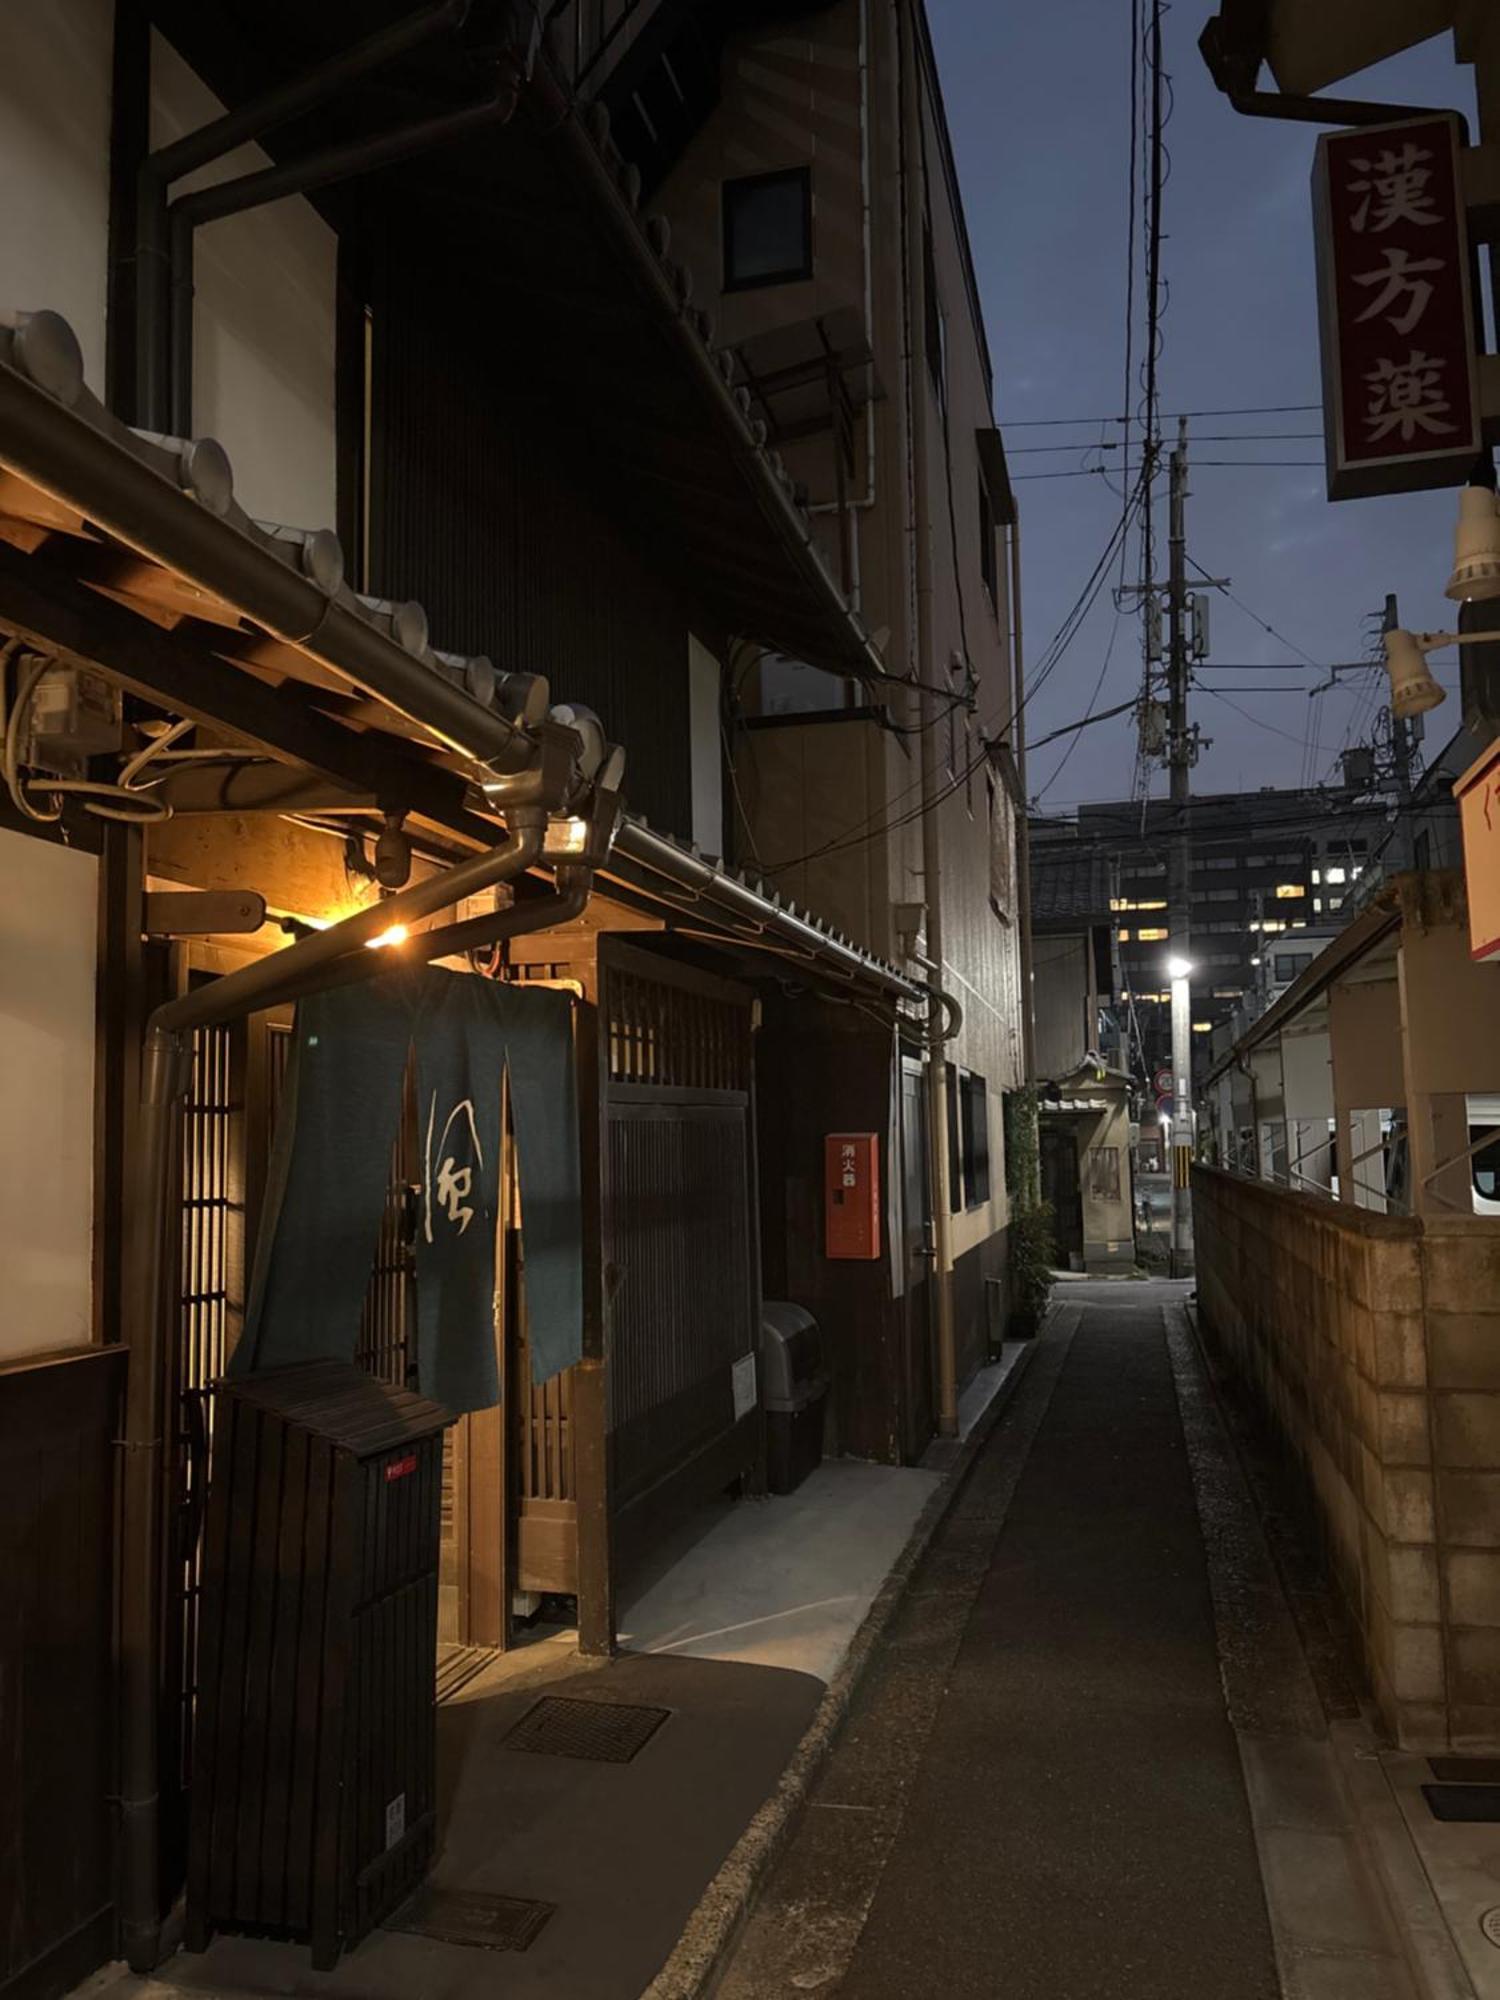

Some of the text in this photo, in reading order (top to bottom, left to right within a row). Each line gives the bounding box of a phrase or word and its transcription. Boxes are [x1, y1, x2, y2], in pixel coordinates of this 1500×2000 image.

[1345, 142, 1461, 443] 漢方薬
[841, 1143, 857, 1187] 消火器
